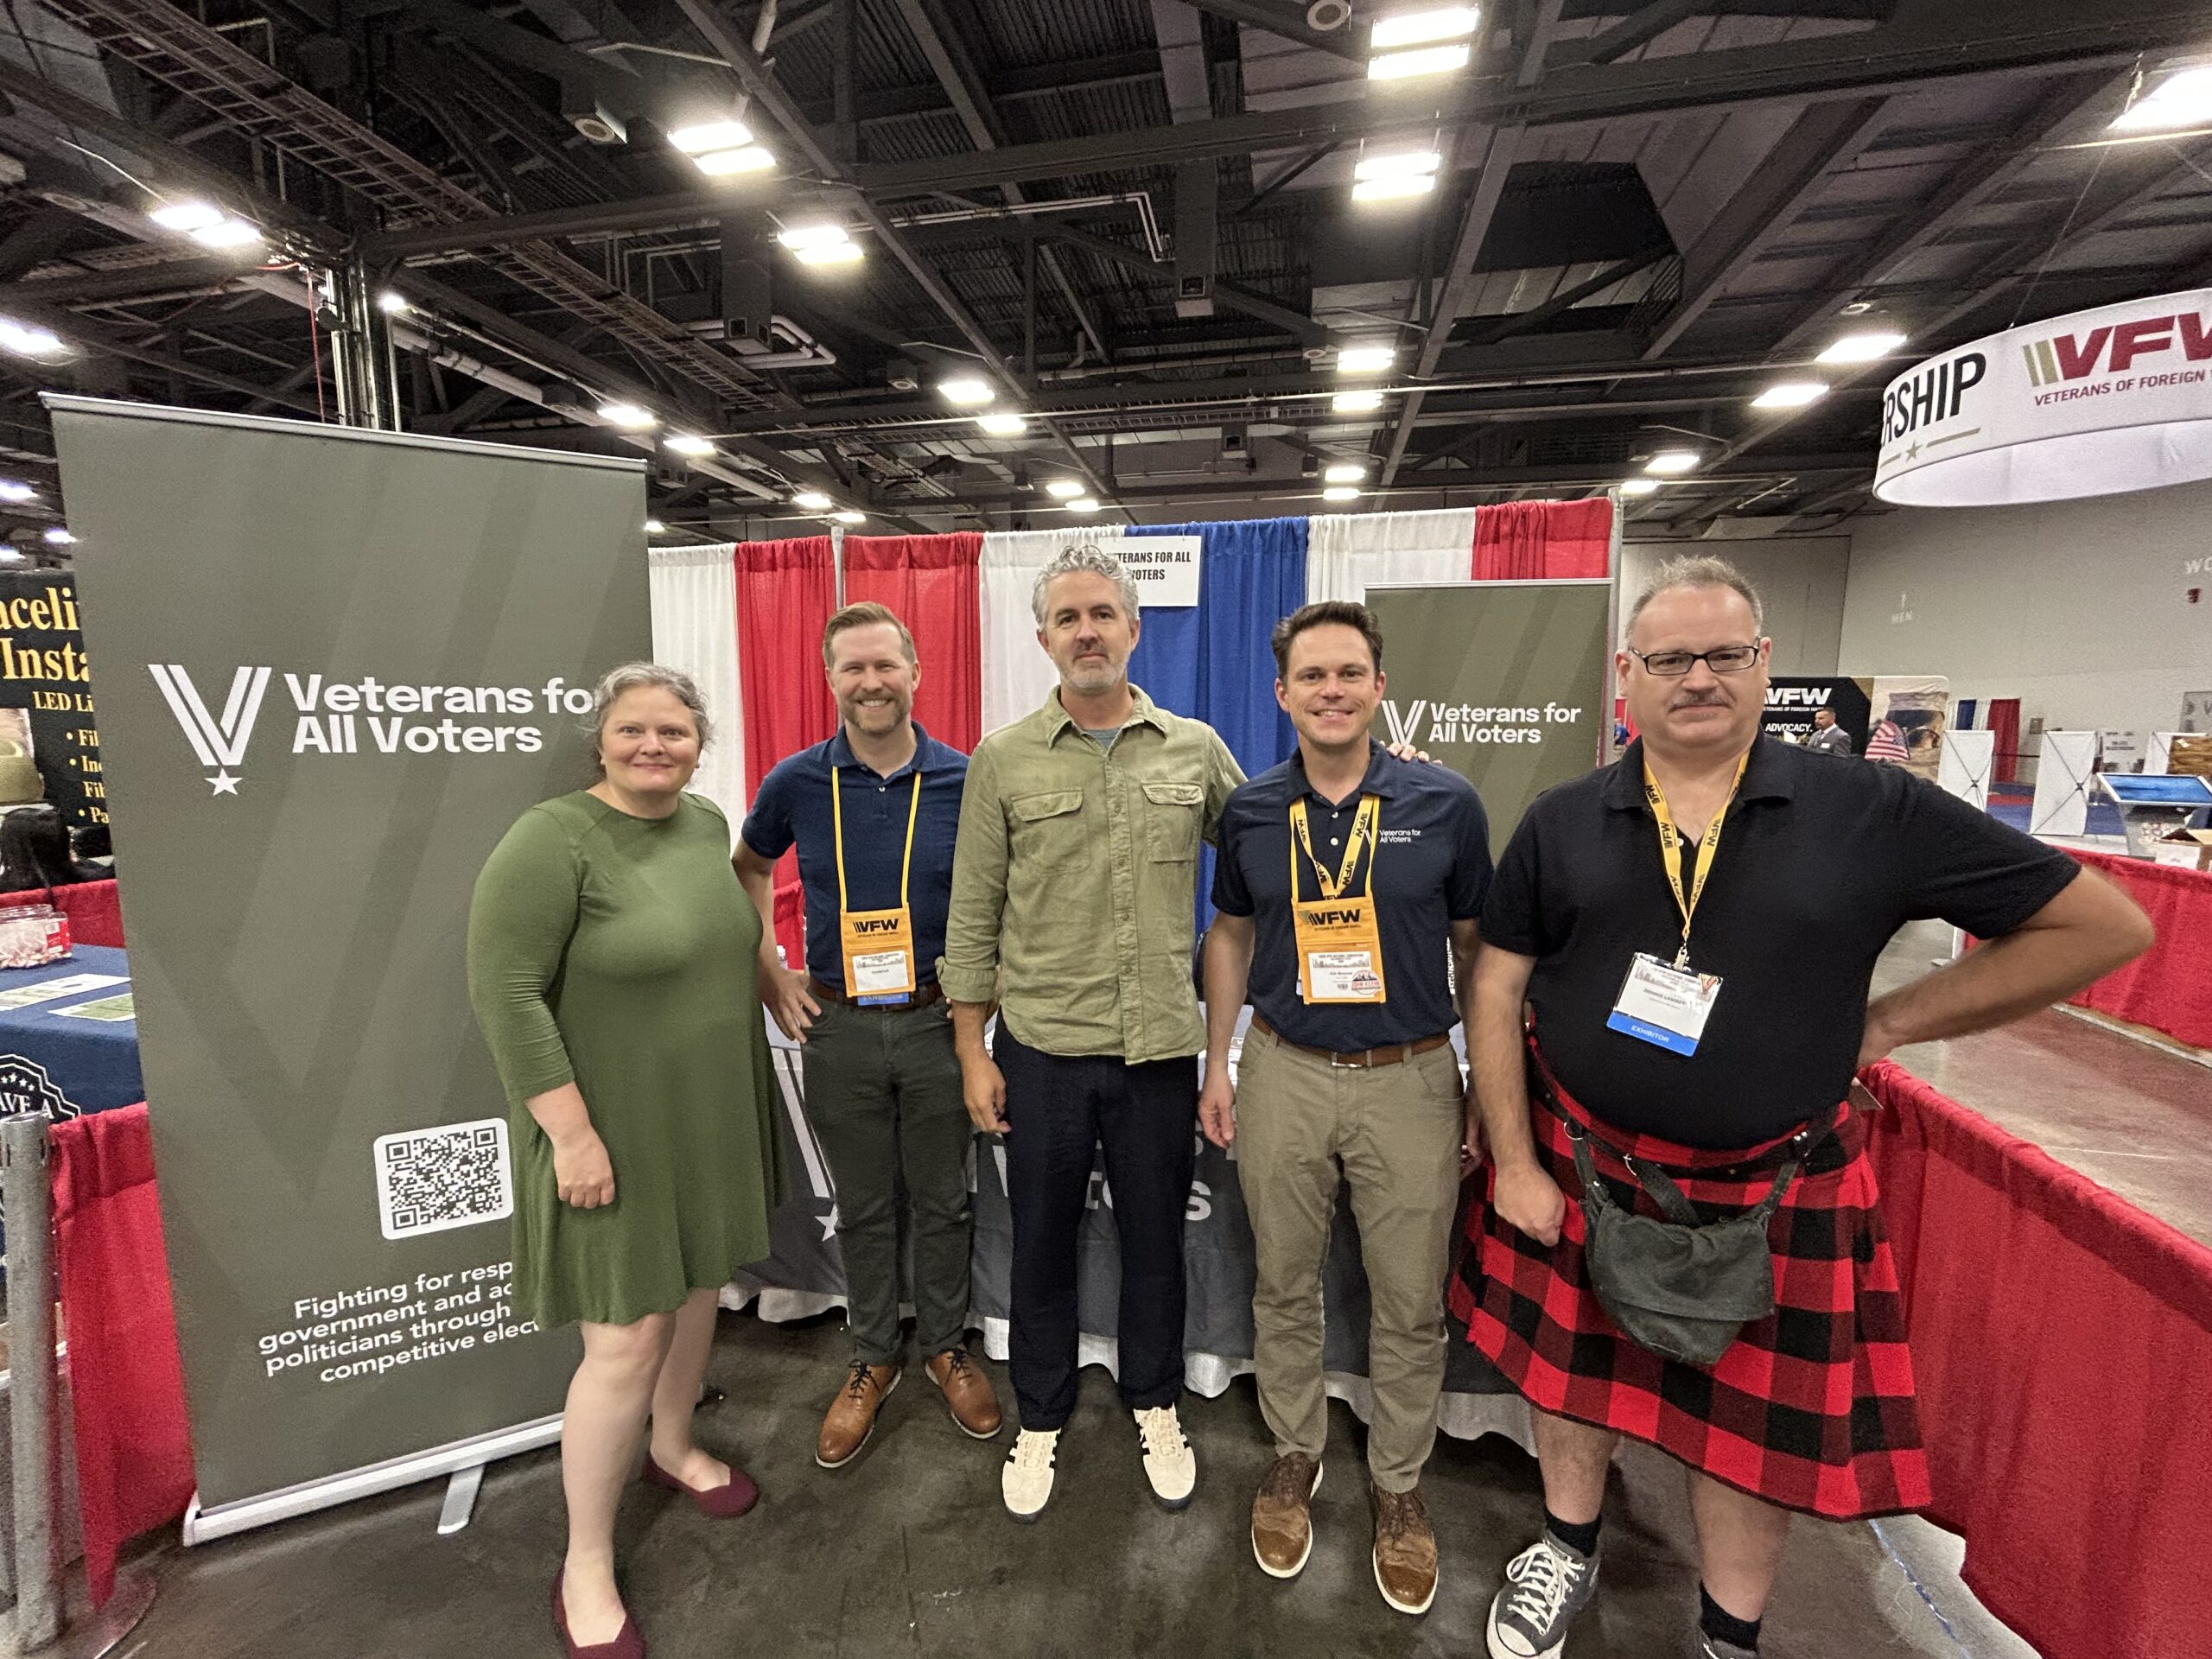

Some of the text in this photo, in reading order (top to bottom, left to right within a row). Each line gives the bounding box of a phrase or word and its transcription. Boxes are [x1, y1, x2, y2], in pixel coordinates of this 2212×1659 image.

[2035, 370, 2206, 405] VETERANS OF FOREIGN
[1882, 353, 1986, 447] RSHIP
[1110, 551, 1191, 563] TERANS FOR ALL
[32, 691, 71, 711] LED
[284, 674, 533, 713] Veterans
[1765, 688, 1832, 704] VFW
[1430, 702, 1581, 723] Veterans for
[292, 715, 543, 753] All Voters
[1428, 722, 1541, 743] All Voters
[1764, 723, 1814, 733] ADVOCACY.
[82, 781, 105, 798] Fil
[857, 918, 899, 932] VFW
[1313, 908, 1360, 925] VFW
[1630, 1025, 1670, 1043] EXHIBITOR
[295, 1262, 512, 1319] Fighting for resp
[259, 1300, 427, 1354] government
[434, 1284, 480, 1311] and
[266, 1301, 511, 1376] politicians through
[320, 1335, 474, 1382] competitive
